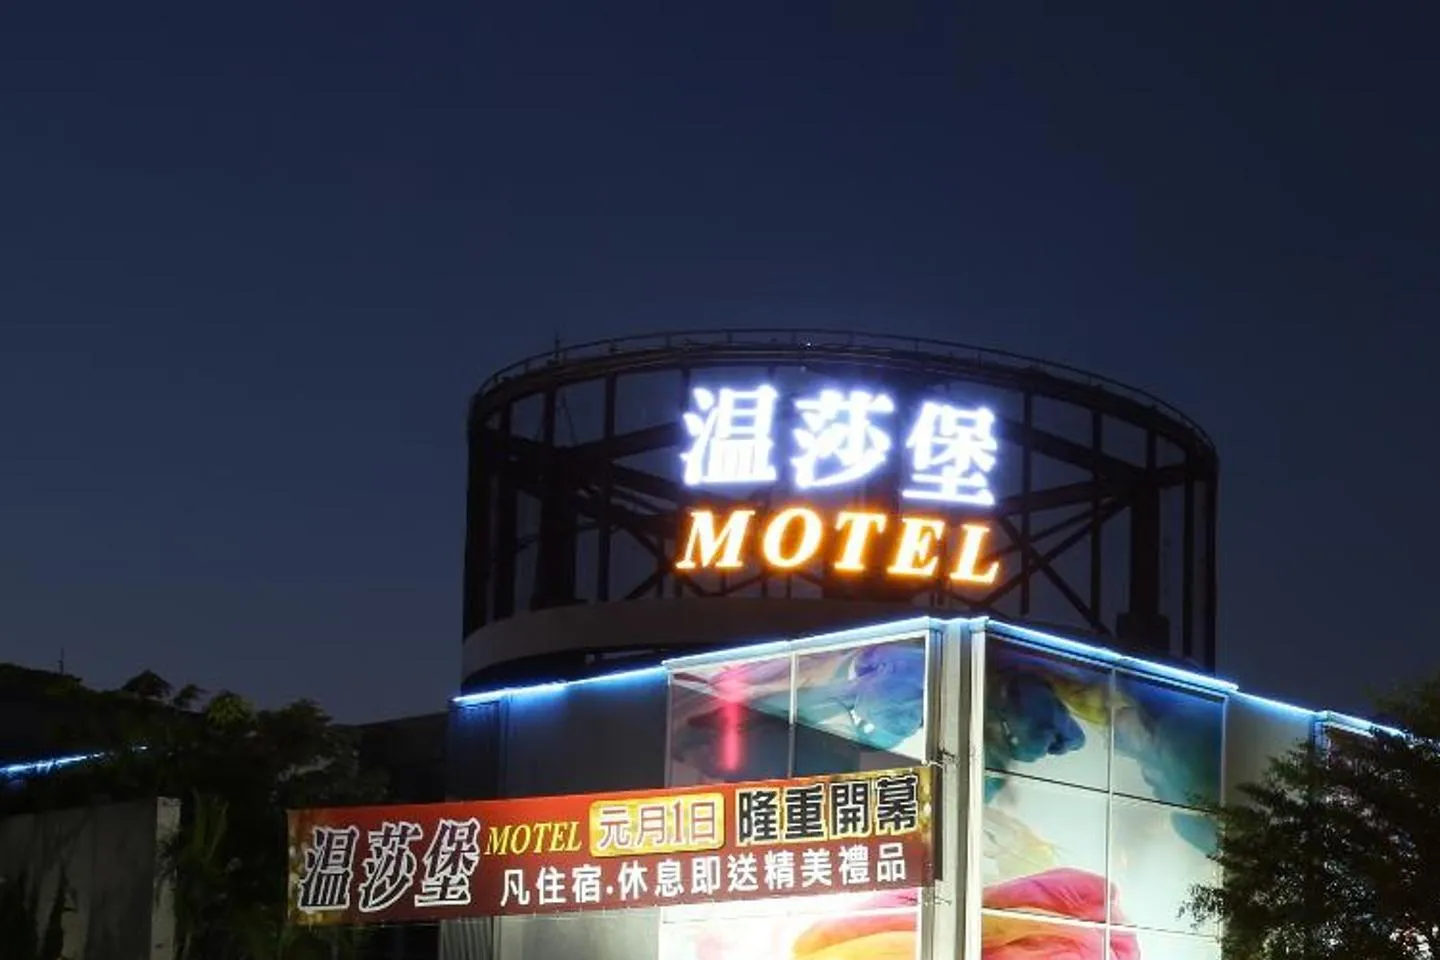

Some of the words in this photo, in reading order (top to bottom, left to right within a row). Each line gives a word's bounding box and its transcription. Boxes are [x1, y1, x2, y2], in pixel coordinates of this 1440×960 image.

[675, 506, 1000, 584] MOTEL
[484, 820, 582, 855] MOTEL
[598, 800, 717, 849] 元月1日
[737, 775, 918, 847] 隆重開幕
